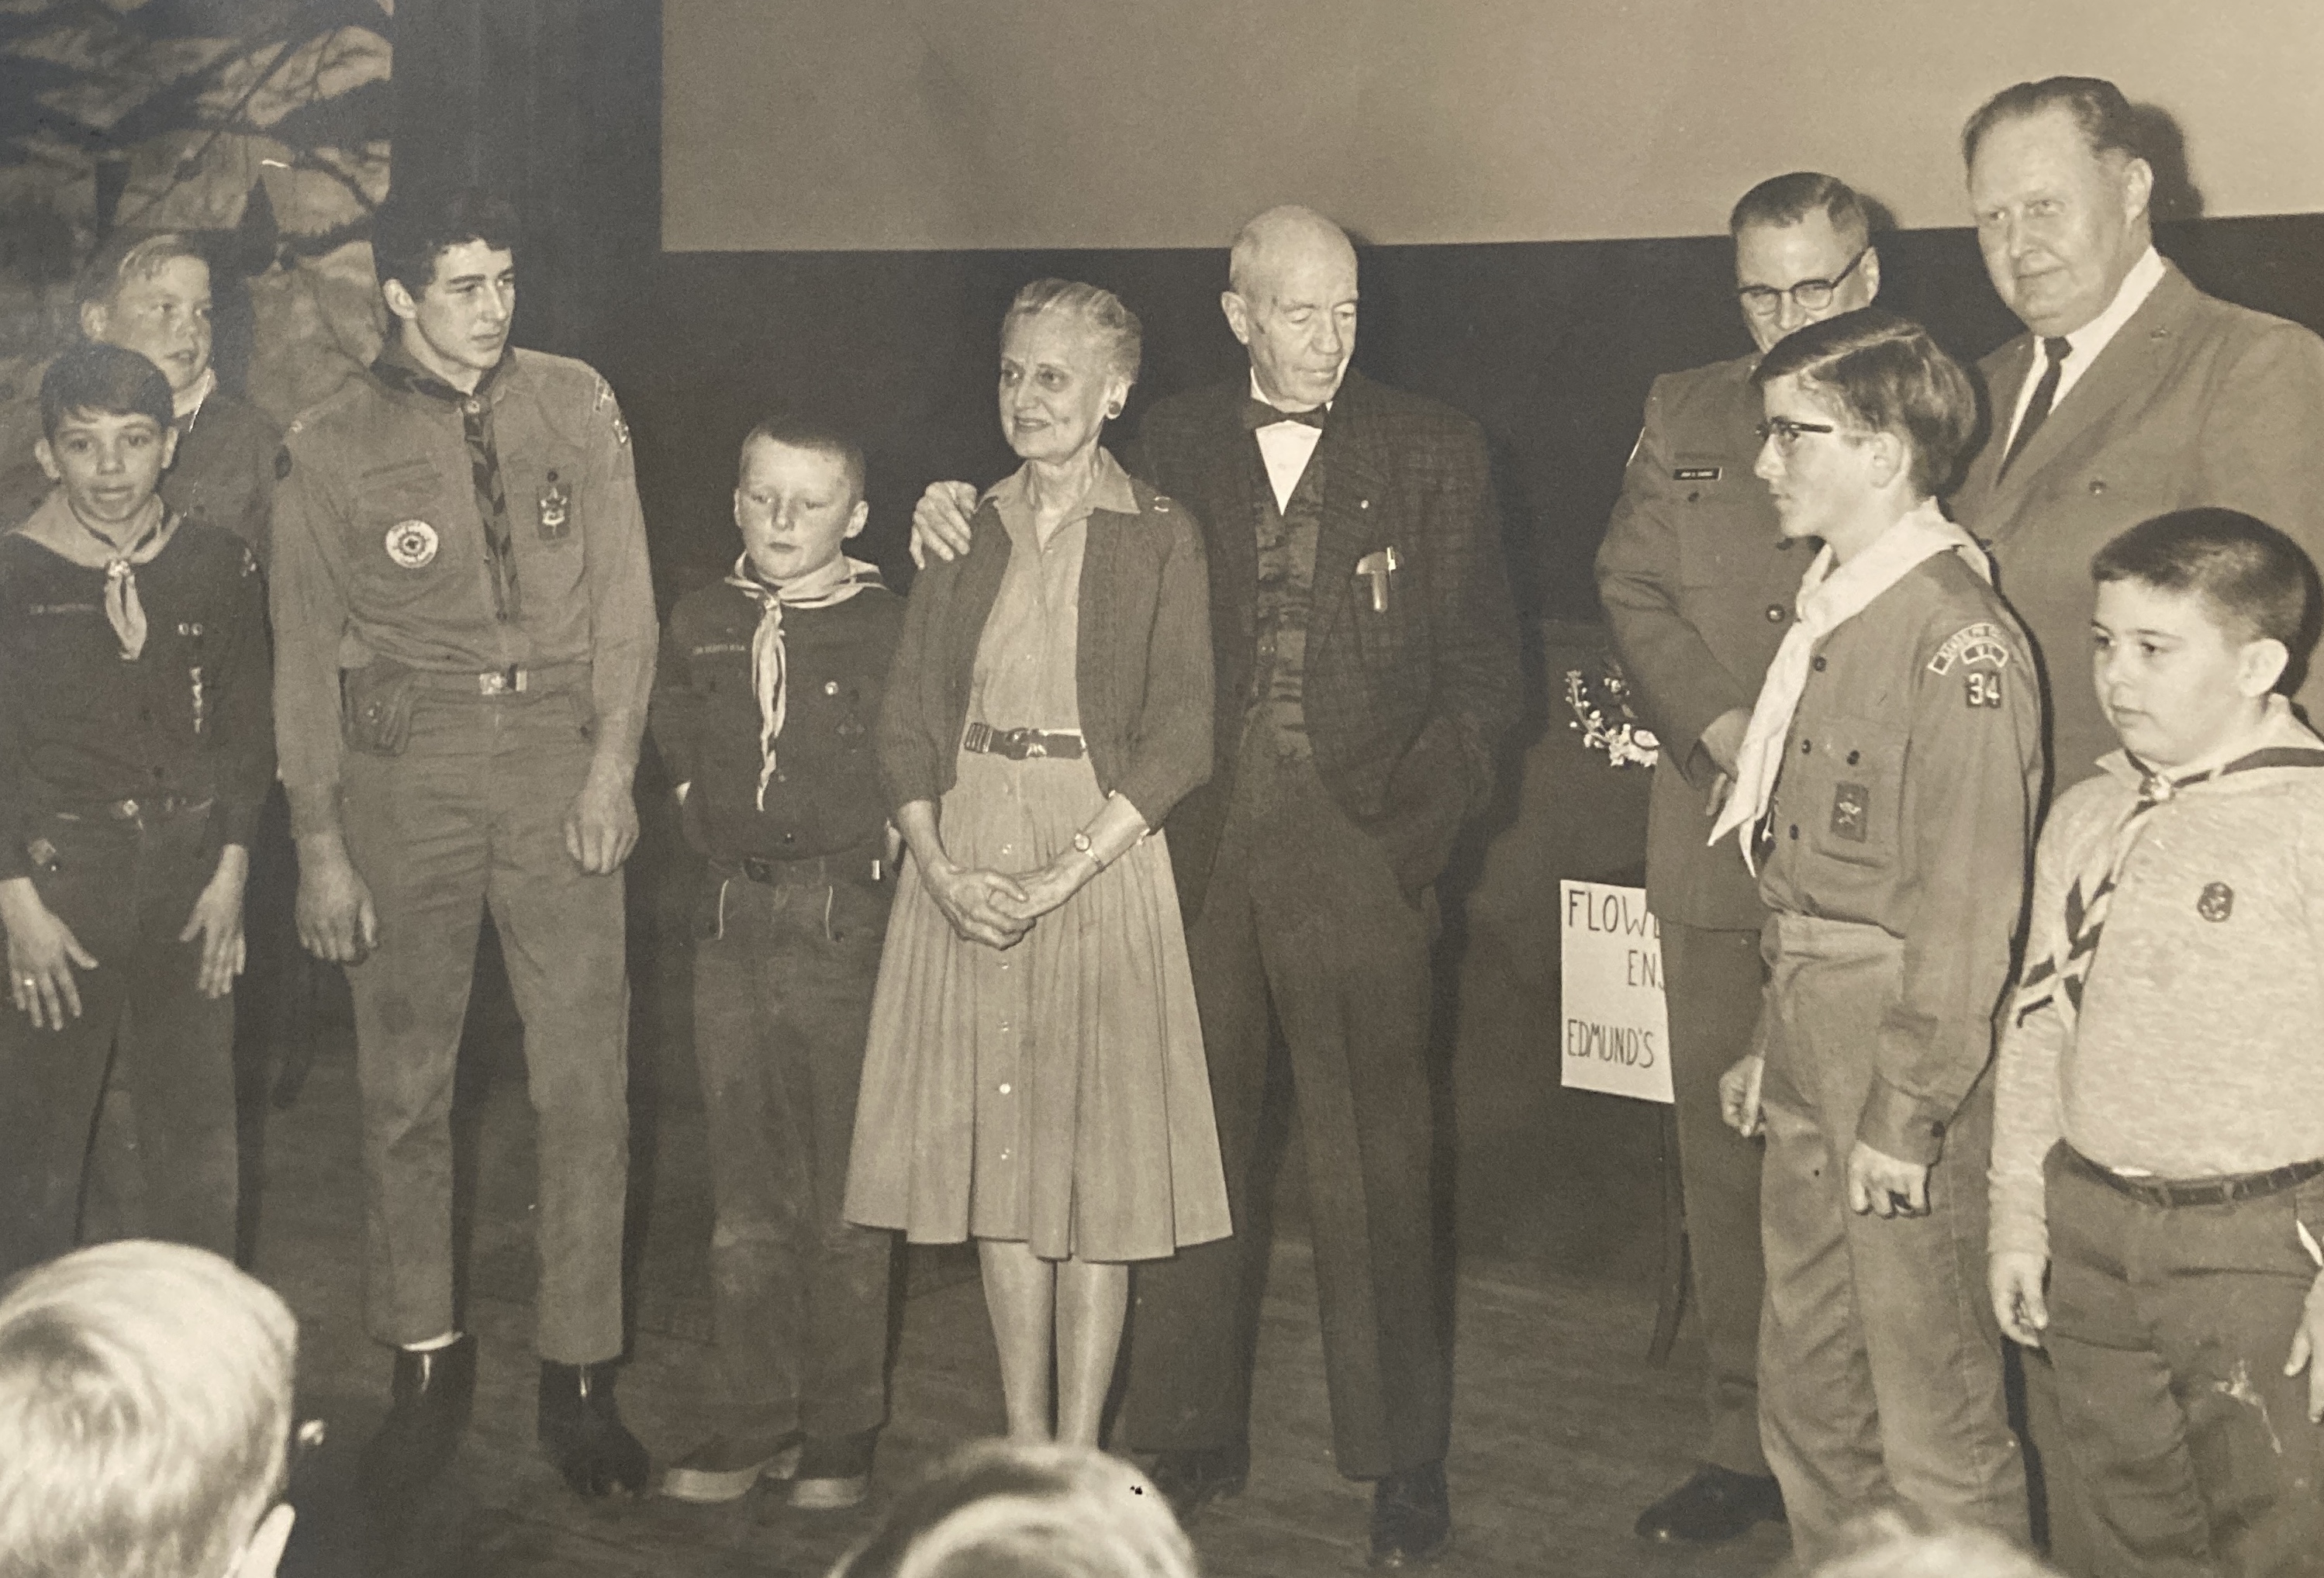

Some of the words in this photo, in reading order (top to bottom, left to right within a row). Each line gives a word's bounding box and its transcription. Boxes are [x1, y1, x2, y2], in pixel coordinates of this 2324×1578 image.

[1970, 673, 1999, 706] 34
[1627, 950, 1664, 991] EN
[1568, 1019, 1654, 1069] EDMUND'S
